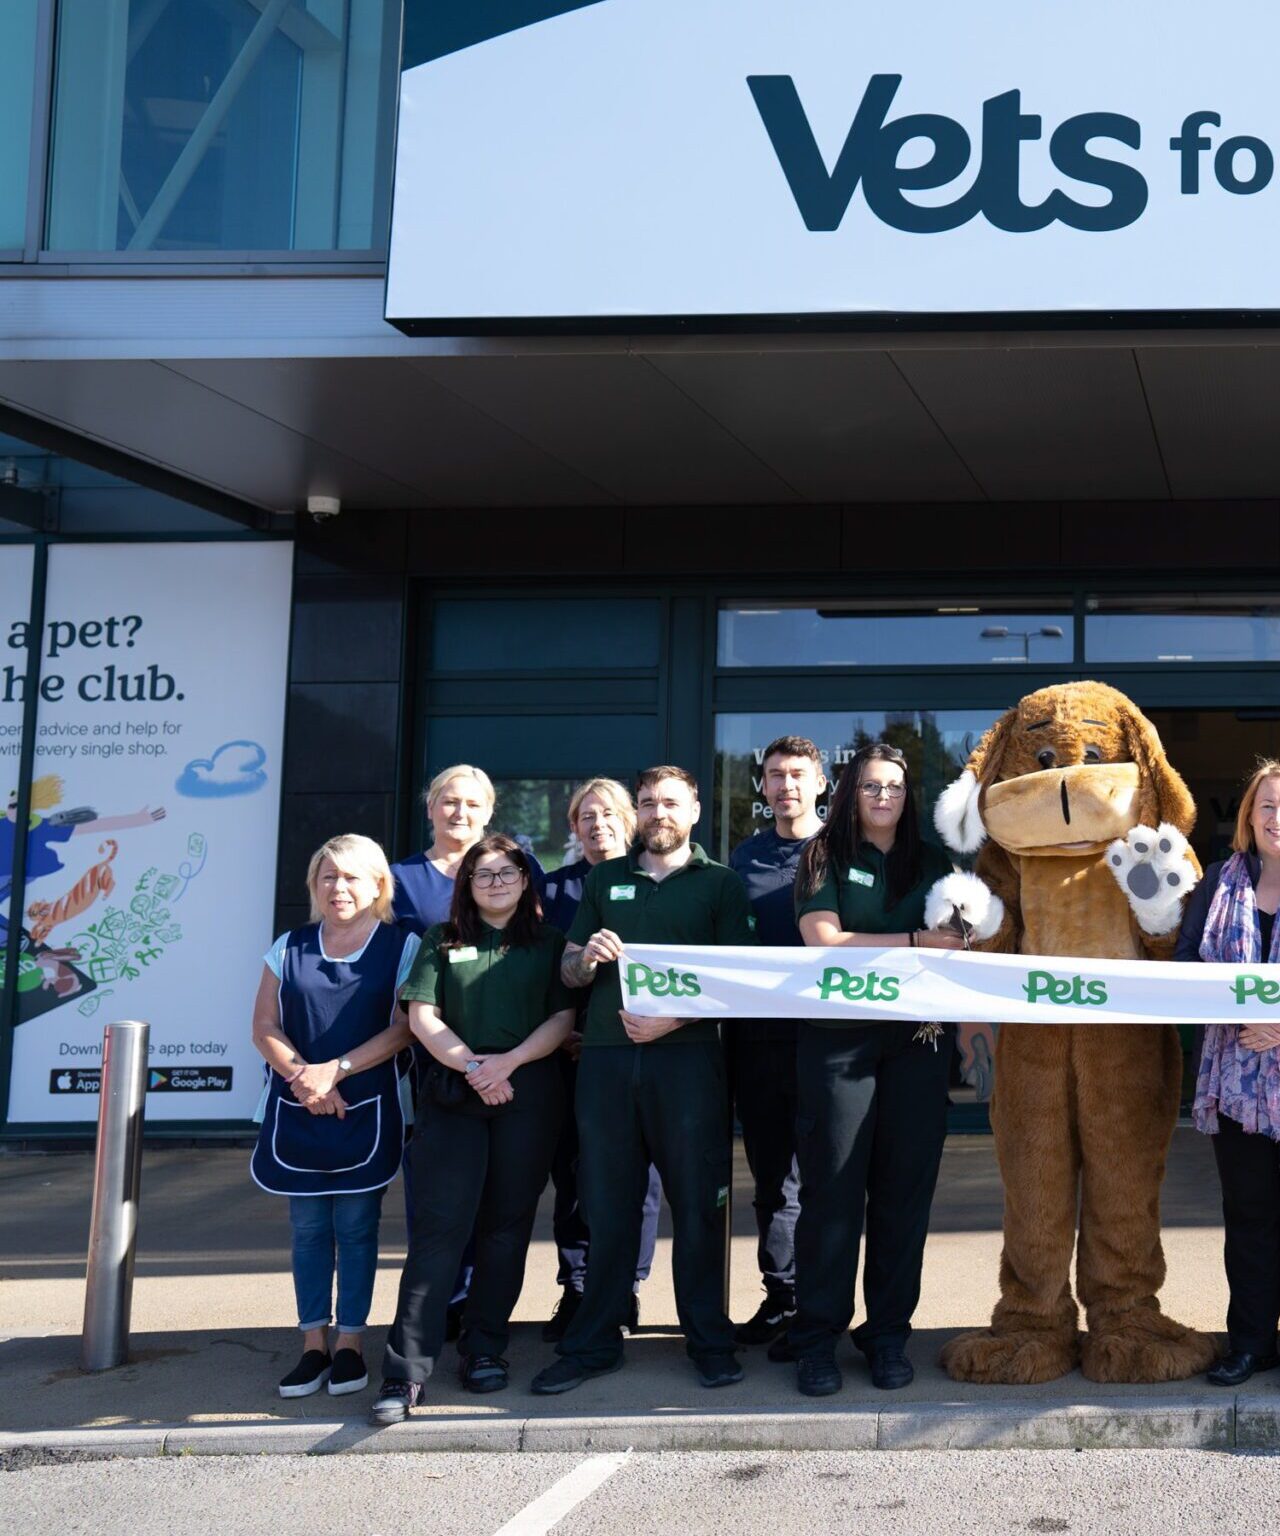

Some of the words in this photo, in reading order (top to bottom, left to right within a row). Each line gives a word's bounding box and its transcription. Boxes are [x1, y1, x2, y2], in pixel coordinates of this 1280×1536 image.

[746, 74, 1149, 233] Vets
[47, 615, 143, 658] pet?
[77, 664, 185, 702] club.
[39, 722, 88, 736] advice
[93, 722, 121, 735] and
[126, 721, 158, 738] help
[163, 720, 182, 735] for
[35, 745, 78, 758] every
[81, 742, 124, 758] single
[128, 741, 167, 757] shop.
[624, 962, 701, 997] Pets
[816, 967, 901, 1002] Pets
[1021, 970, 1108, 1006] Pets
[59, 1043, 102, 1055] Downl
[160, 1044, 186, 1057] app
[190, 1042, 228, 1056] today
[76, 1079, 100, 1091] App
[171, 1076, 206, 1089] Google
[207, 1076, 228, 1088] Play
